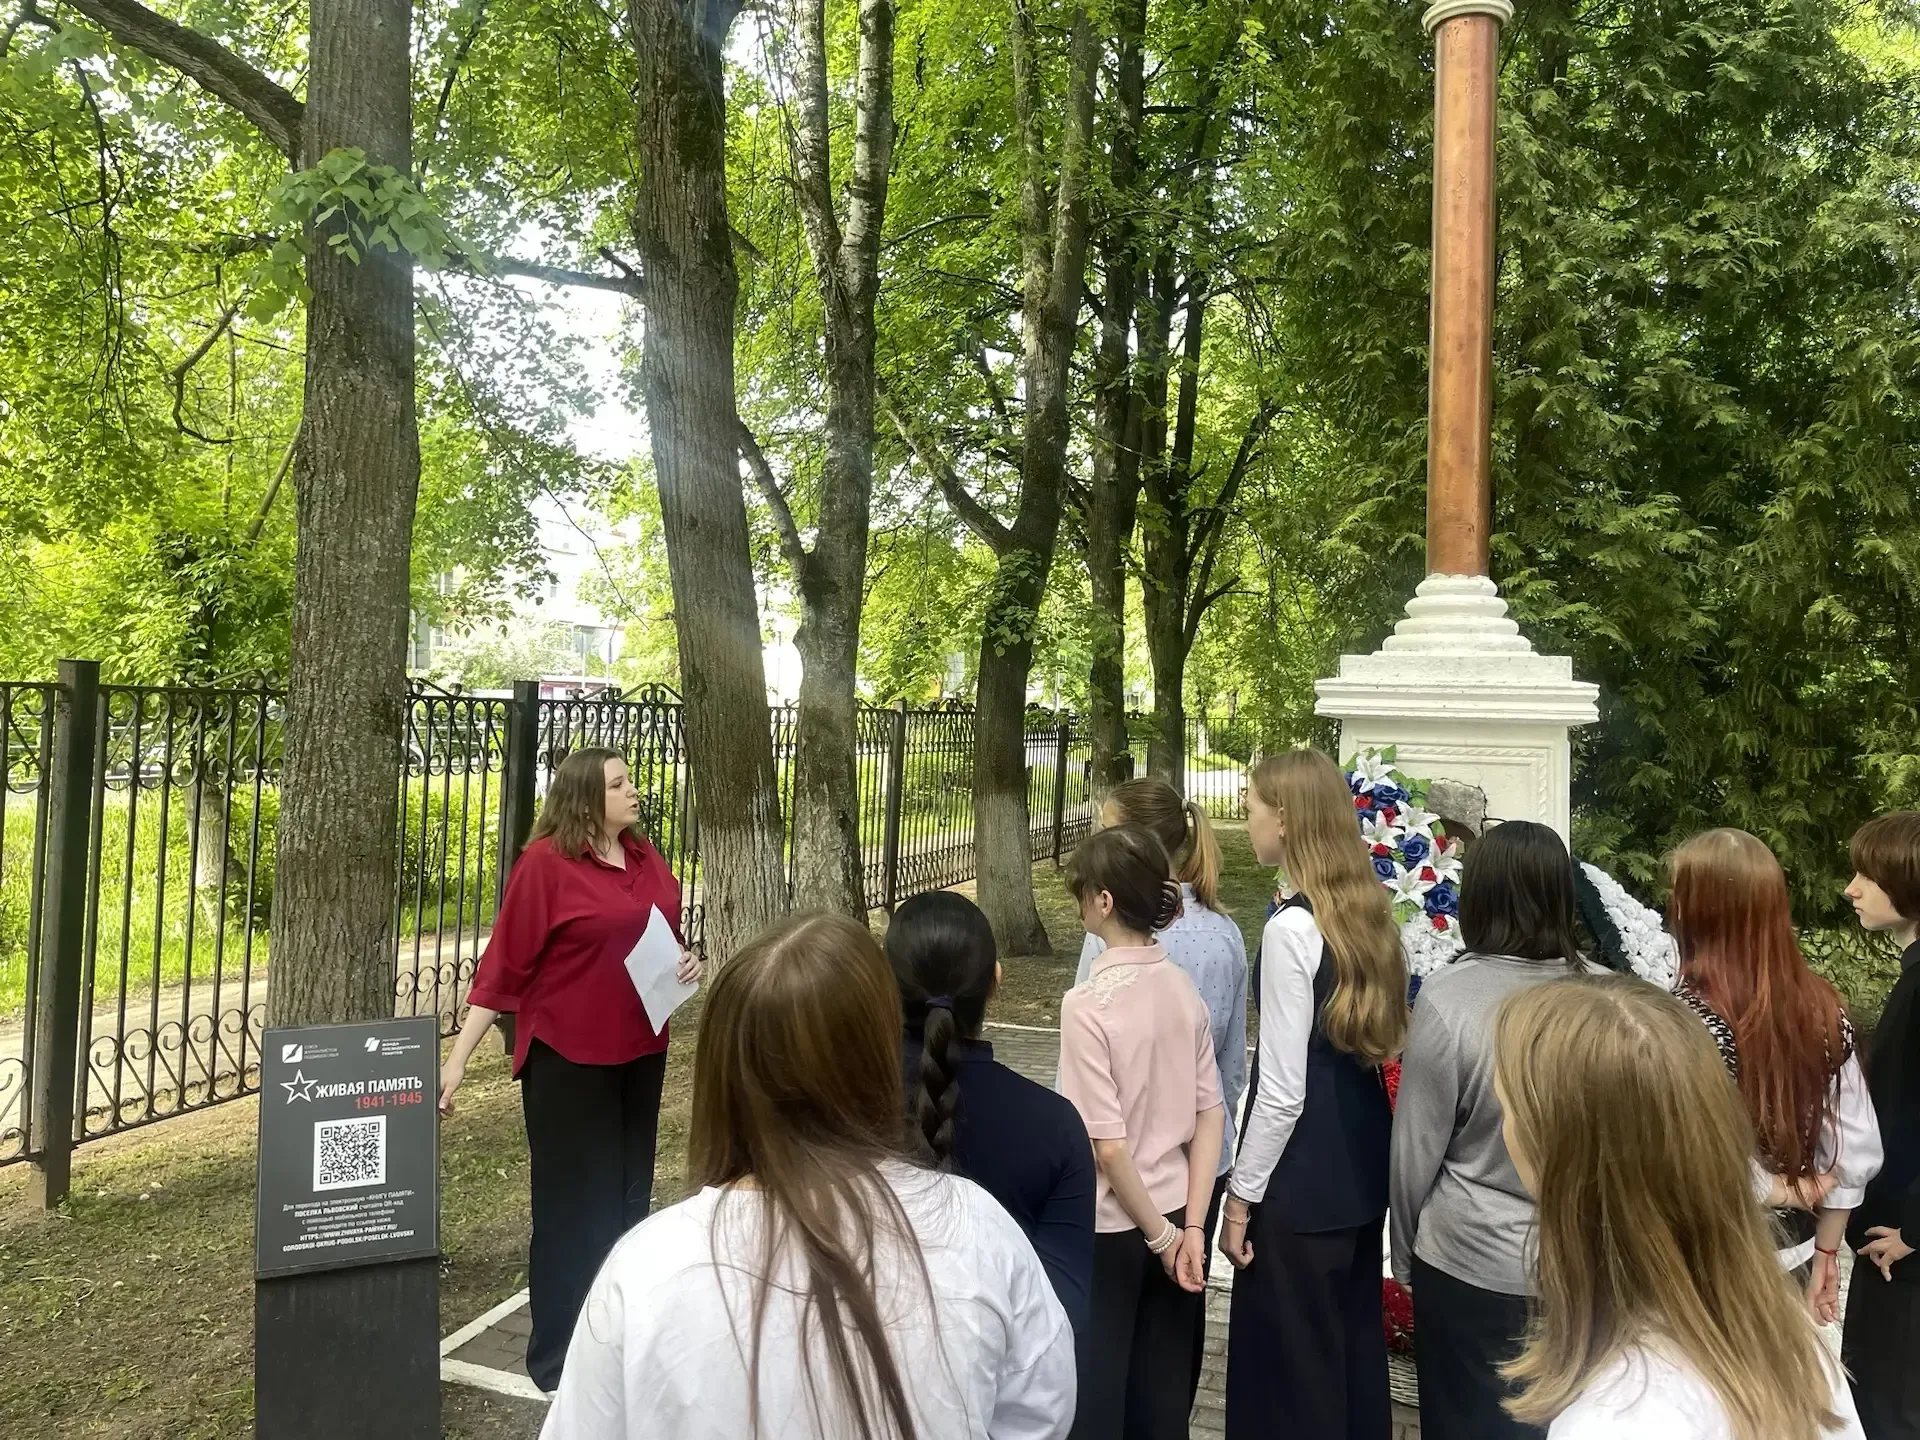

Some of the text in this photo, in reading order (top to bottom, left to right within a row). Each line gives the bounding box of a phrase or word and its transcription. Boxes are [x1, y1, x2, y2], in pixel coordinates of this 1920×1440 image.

[315, 1076, 423, 1099] ЖИВАЯ ПАМЯТЬ
[355, 1091, 423, 1110] 1941-1945
[283, 1204, 295, 1212] Для
[295, 1201, 321, 1210] перехода
[329, 1196, 366, 1206] электронную
[294, 1208, 322, 1217] ПОСЕЛКА
[322, 1203, 358, 1214] ЛЬВОВСКИЙ
[306, 1216, 334, 1224] помощью
[334, 1212, 368, 1221] мобильного
[368, 1208, 395, 1216] телефона
